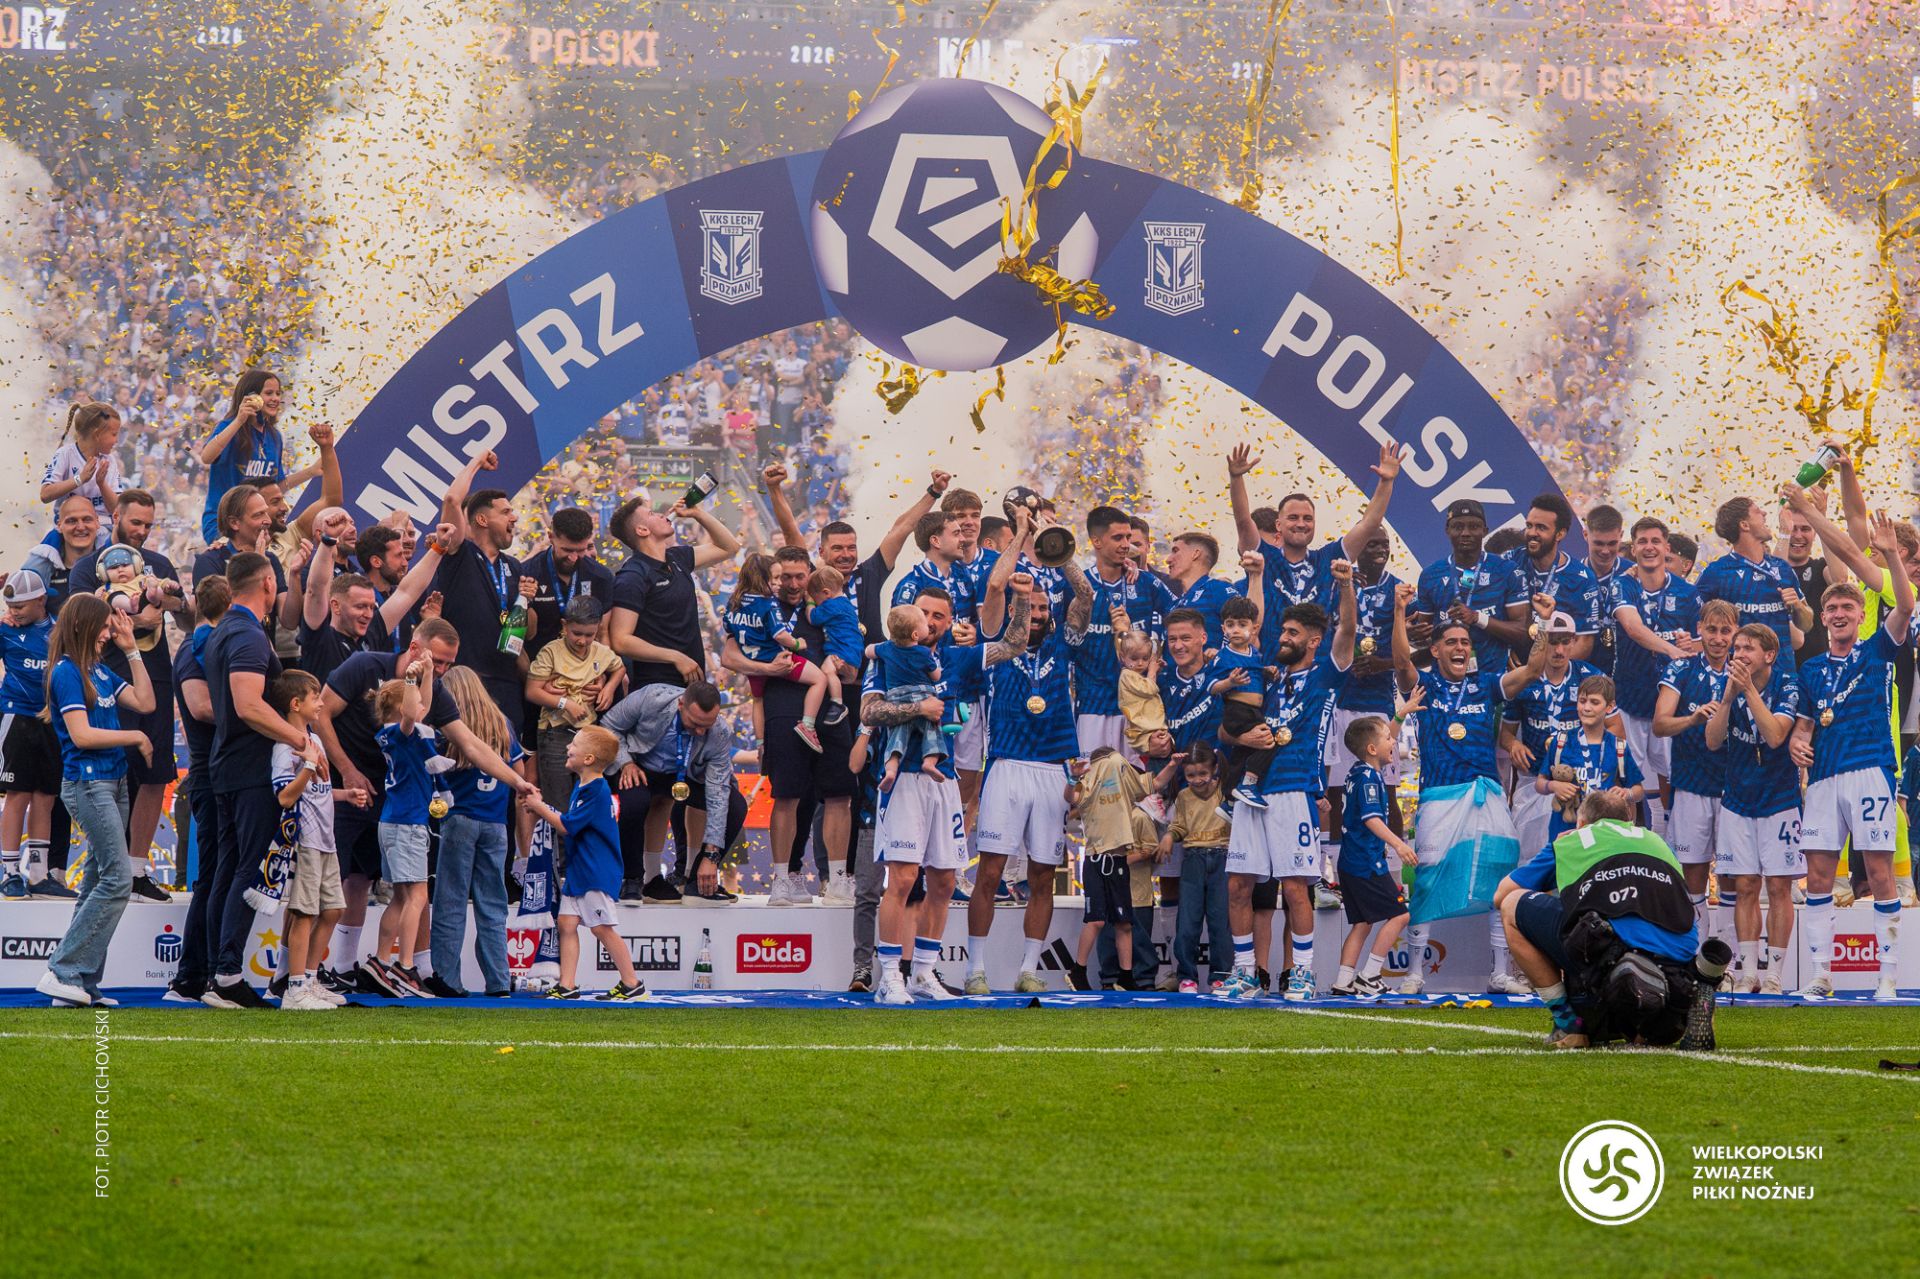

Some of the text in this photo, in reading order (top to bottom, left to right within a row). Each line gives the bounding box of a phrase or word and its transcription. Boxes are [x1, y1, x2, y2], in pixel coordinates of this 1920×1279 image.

[529, 27, 659, 67] POLSKI
[709, 215, 754, 226] KKS LECH
[1153, 227, 1196, 238] KKS LECH
[355, 271, 645, 540] MISTRZ
[23, 658, 49, 670] SUP
[1167, 695, 1213, 730] UPERBET
[1431, 698, 1486, 714] SUPRBET
[311, 782, 332, 794] SUP
[1099, 794, 1122, 805] SUP
[1861, 796, 1890, 822] 27
[951, 812, 965, 839] 2
[1298, 822, 1310, 847] 8
[1778, 820, 1801, 846] 43
[1594, 865, 1673, 885] EKSTRAKLASA
[4, 939, 59, 957] CANA
[743, 940, 806, 963] Duda
[1387, 946, 1432, 970] LOO
[146, 970, 165, 979] Bank
